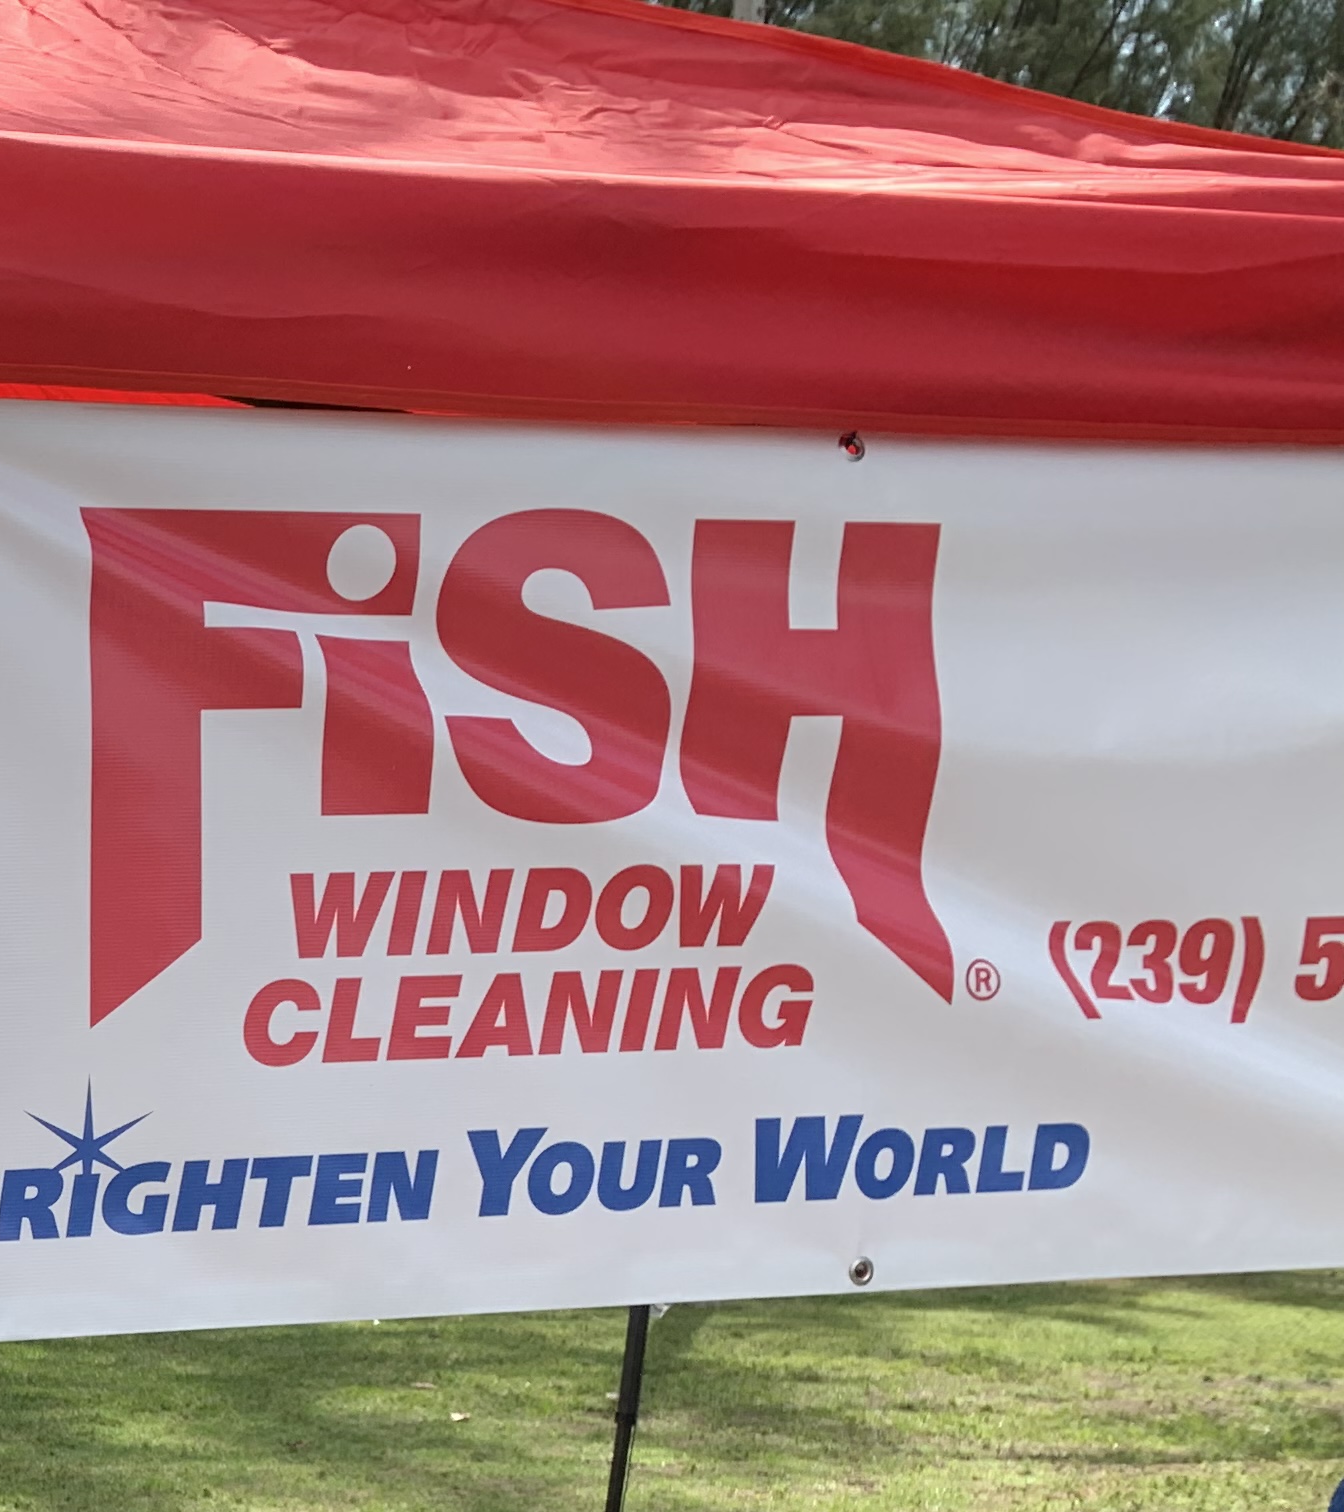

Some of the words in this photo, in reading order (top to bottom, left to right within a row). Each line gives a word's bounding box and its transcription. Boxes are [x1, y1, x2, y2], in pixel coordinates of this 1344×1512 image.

[290, 862, 773, 960] WINDOW
[243, 963, 814, 1068] CLEANING
[1049, 916, 1265, 1024] (239)
